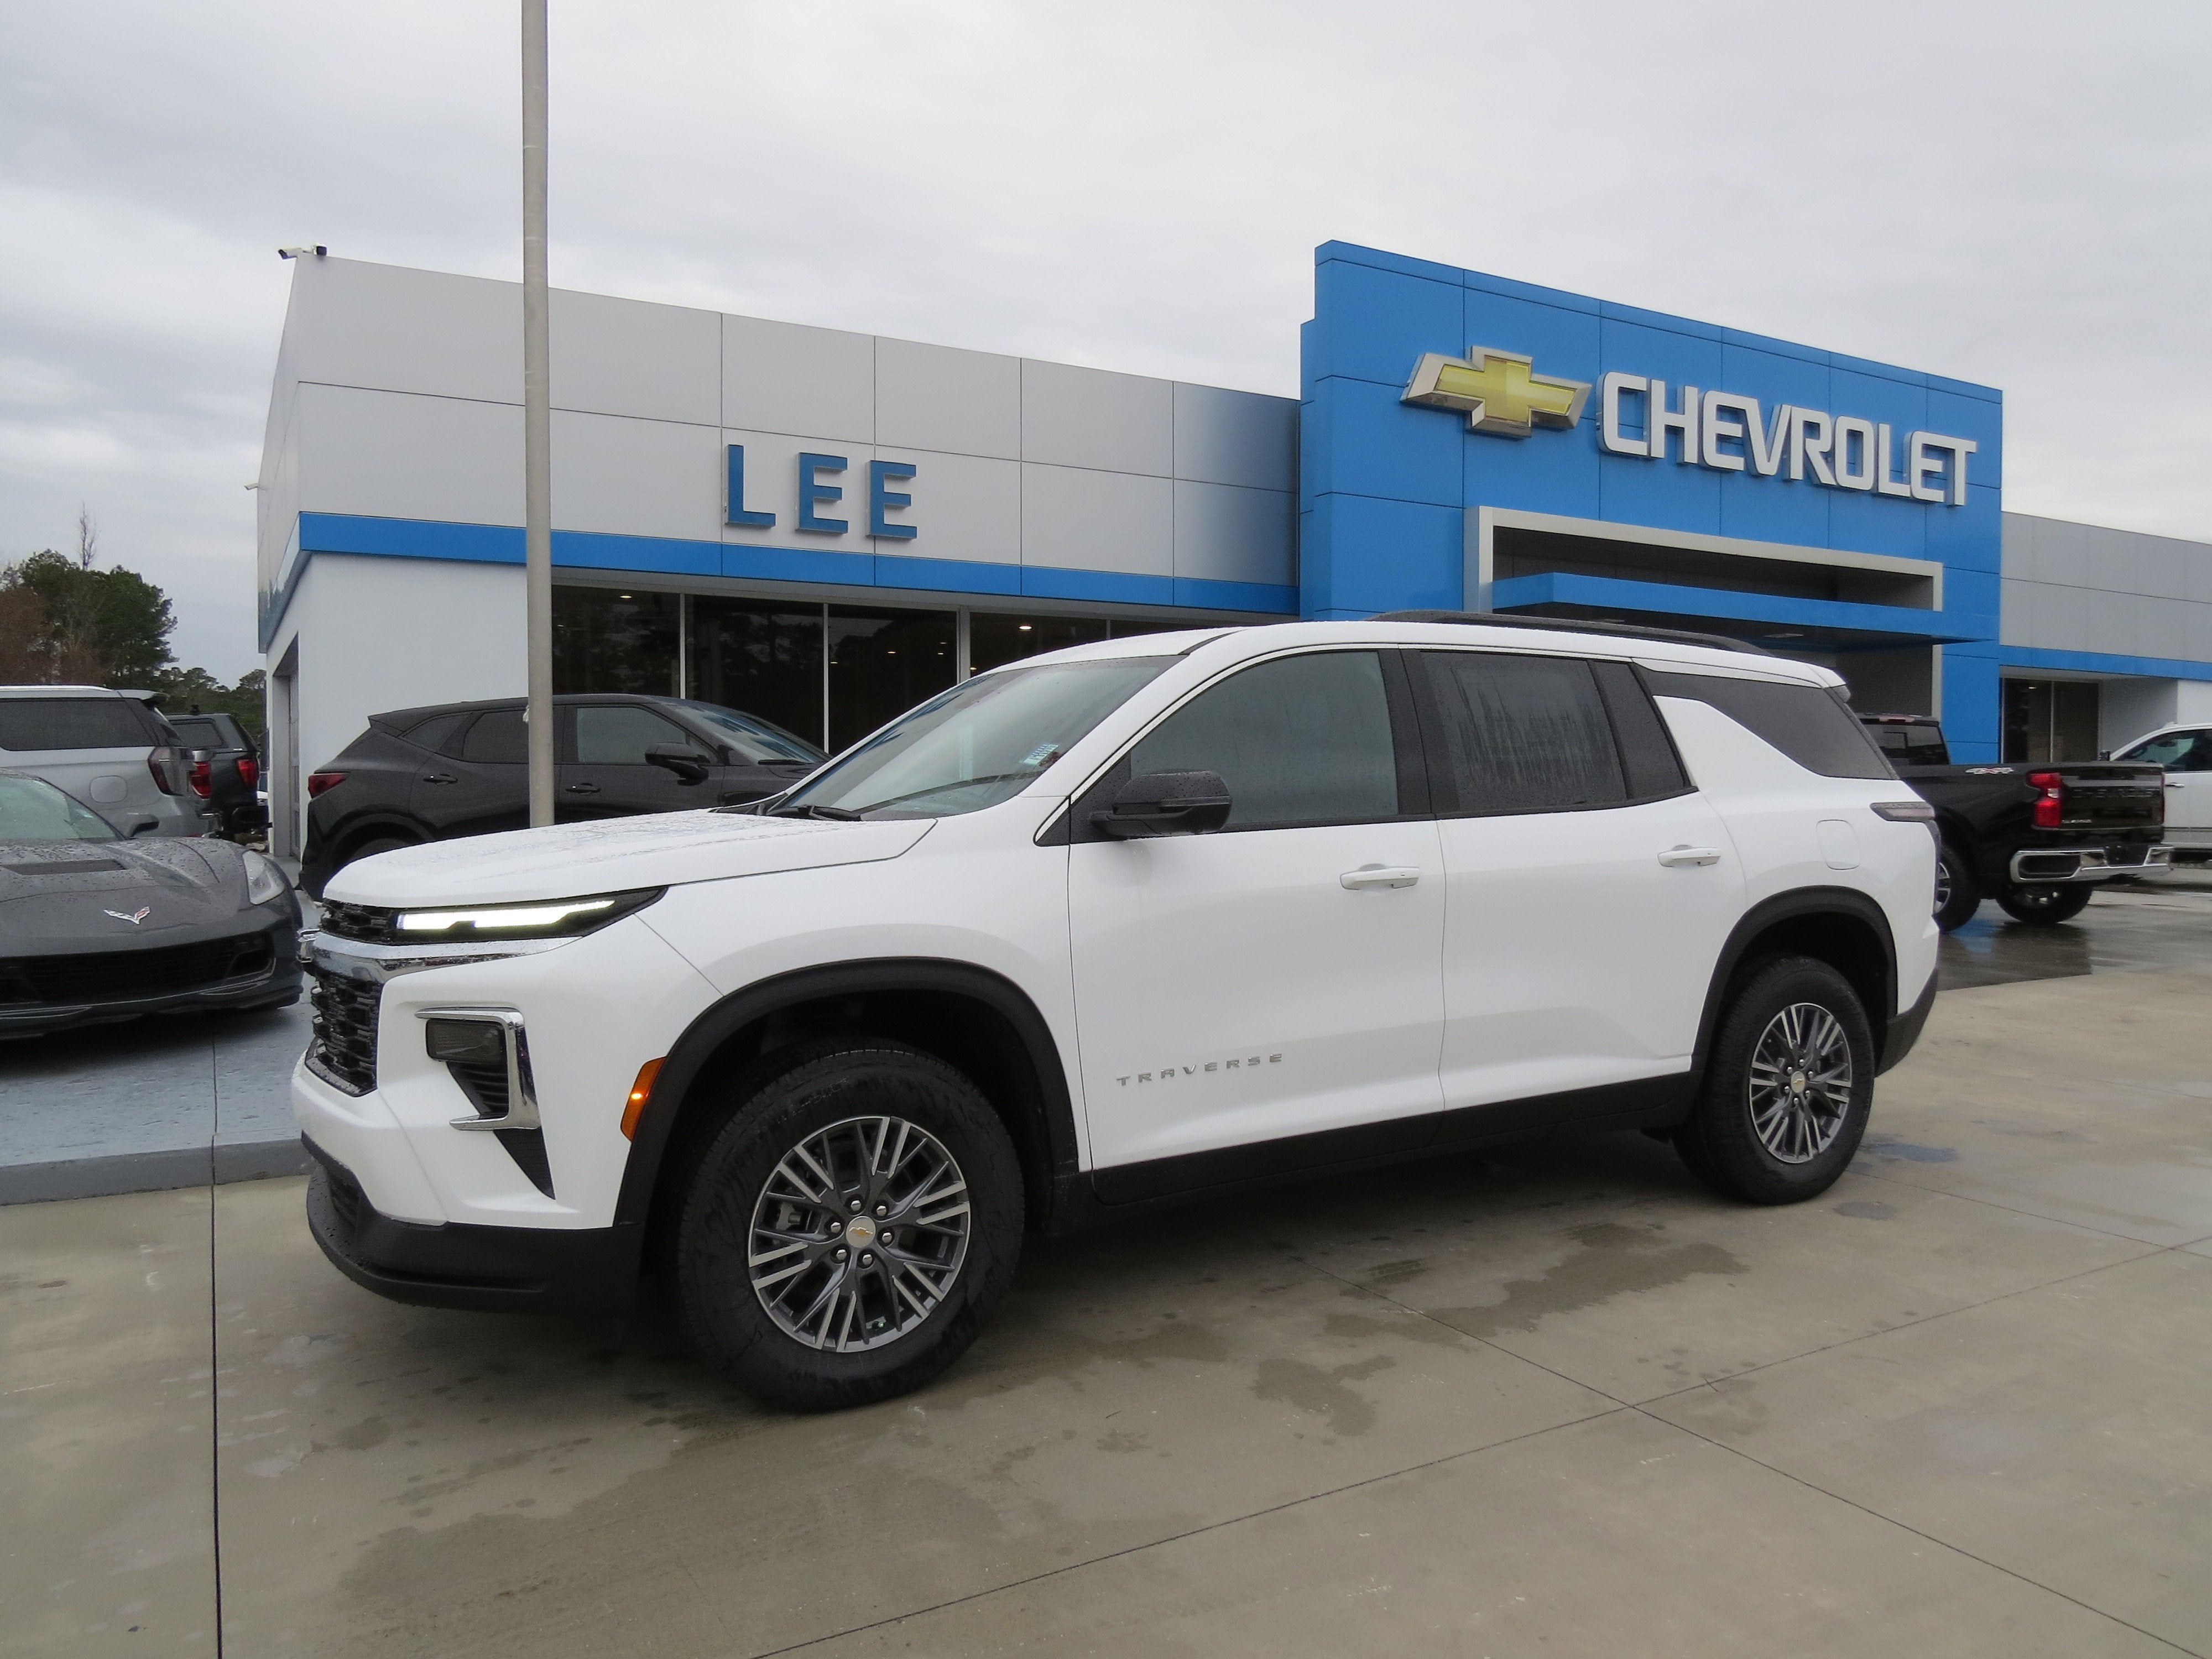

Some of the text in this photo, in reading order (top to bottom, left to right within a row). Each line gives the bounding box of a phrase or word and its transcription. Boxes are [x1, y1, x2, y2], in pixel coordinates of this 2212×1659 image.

[1597, 371, 1977, 505] CHEVROLET
[726, 444, 916, 539] LEE
[1116, 1053, 1283, 1086] TRAVERSE
